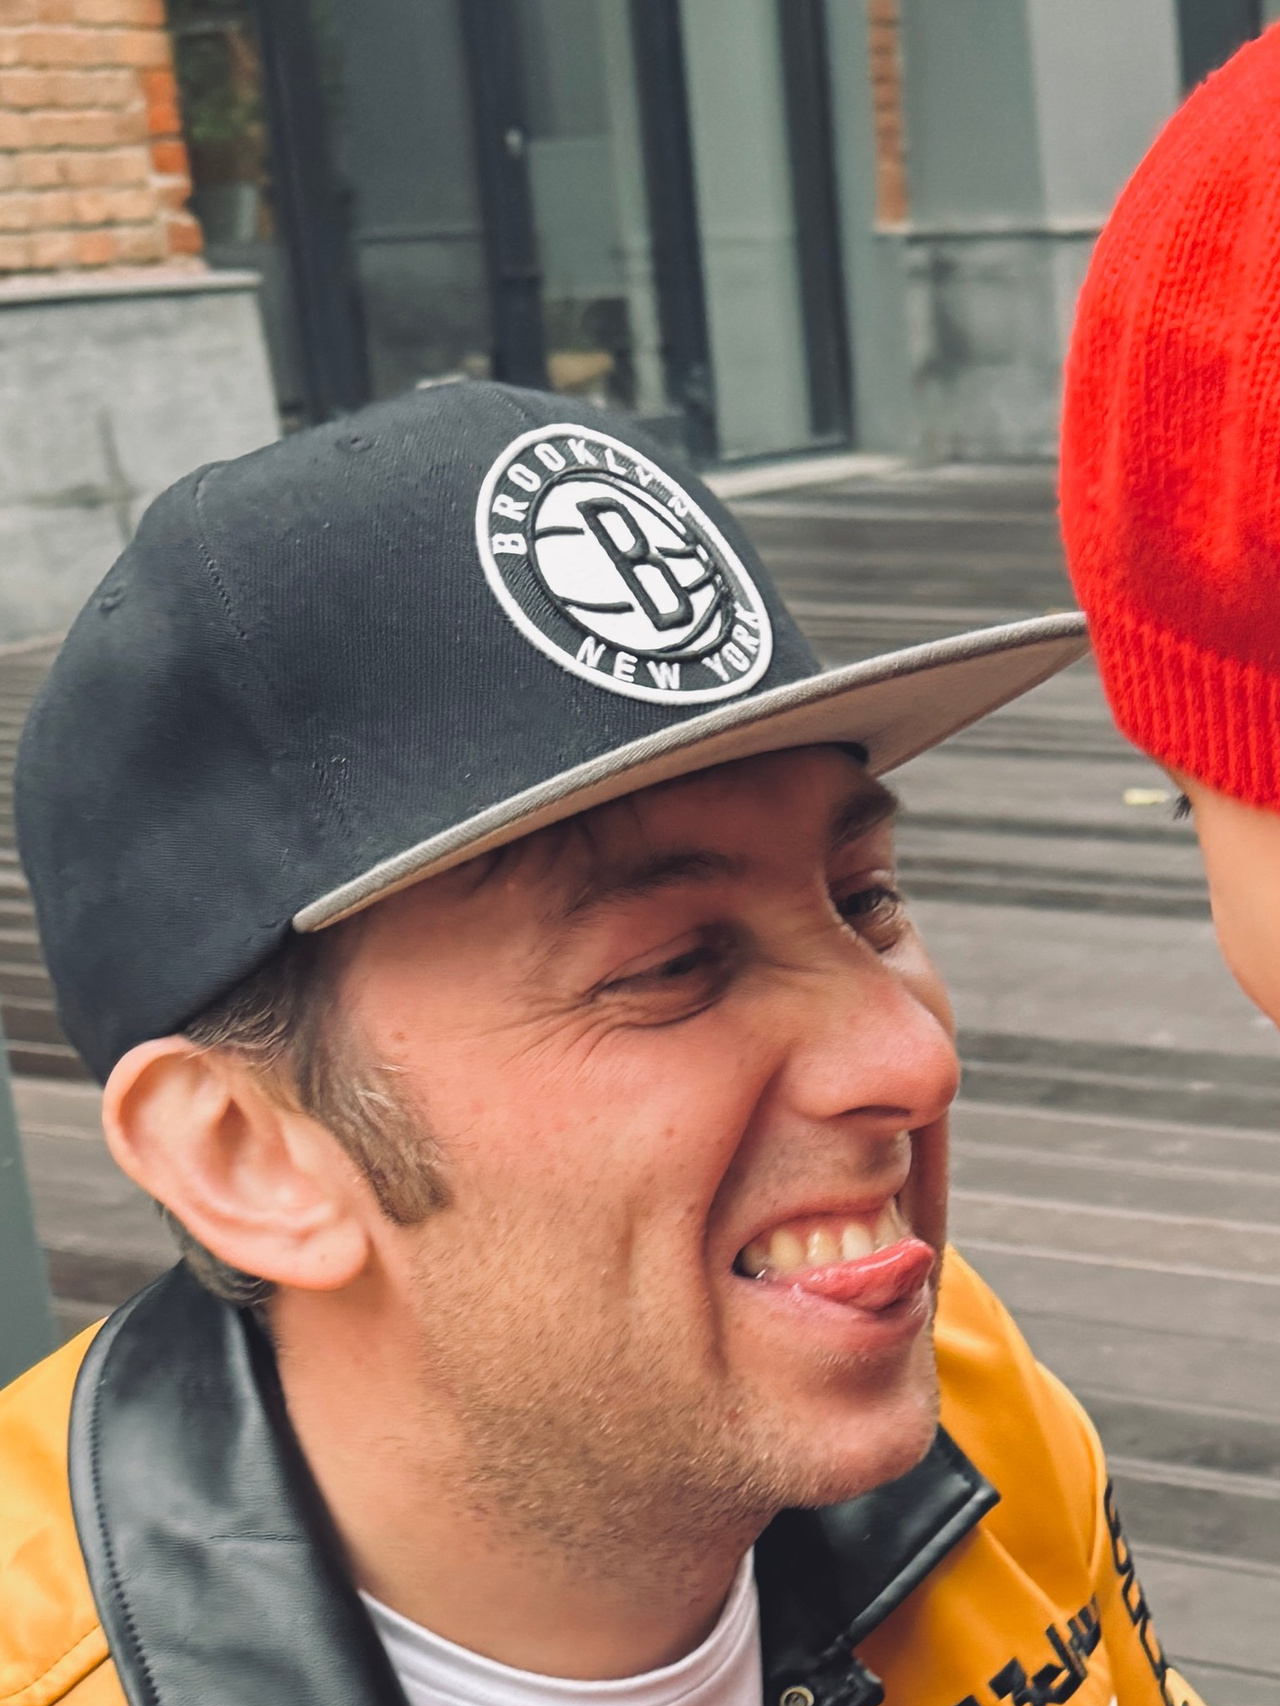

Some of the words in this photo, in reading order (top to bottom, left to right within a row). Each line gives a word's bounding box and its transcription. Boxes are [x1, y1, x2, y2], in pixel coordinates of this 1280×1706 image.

[491, 438, 690, 555] BROOKLYN
[576, 636, 680, 690] NEW
[702, 601, 761, 682] YORK
